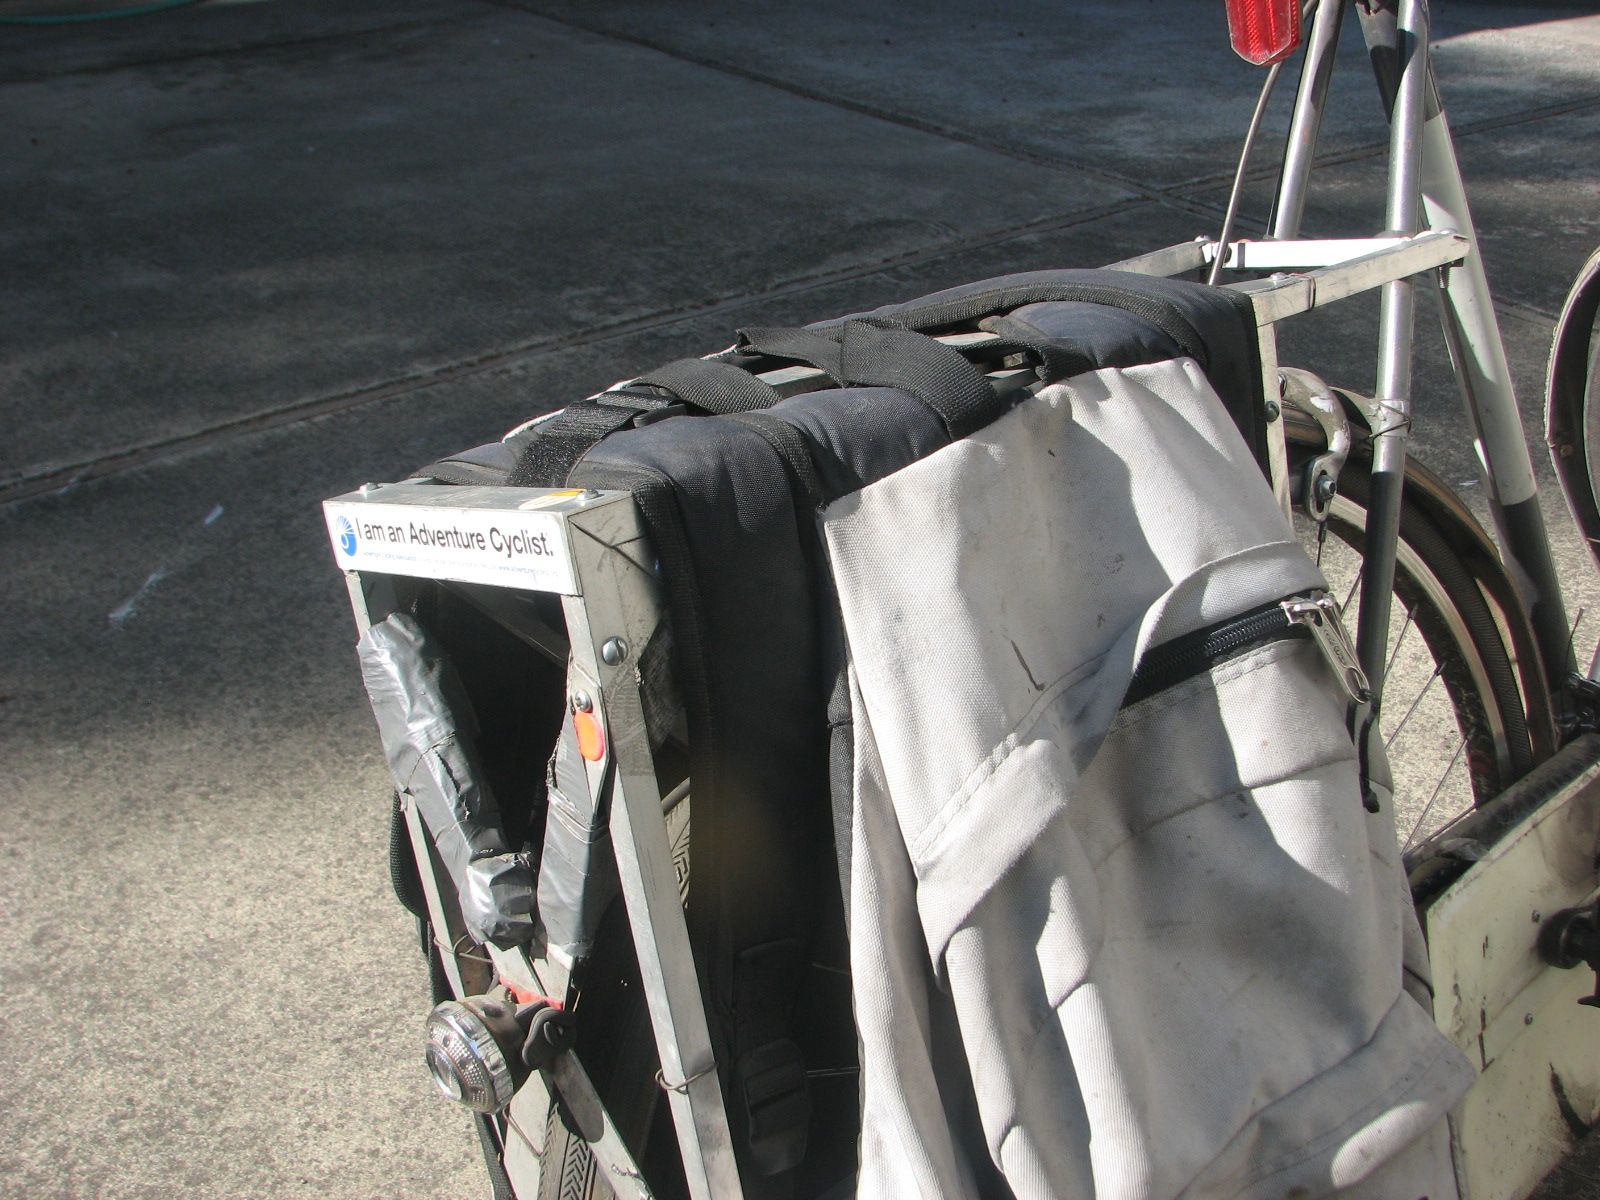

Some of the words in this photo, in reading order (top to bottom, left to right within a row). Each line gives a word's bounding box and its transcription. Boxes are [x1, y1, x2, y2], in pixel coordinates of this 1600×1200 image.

[355, 517, 362, 540] I
[363, 523, 386, 542] am
[387, 525, 406, 543] an
[409, 521, 486, 551] Adventure
[489, 526, 554, 558] Cyclist.
